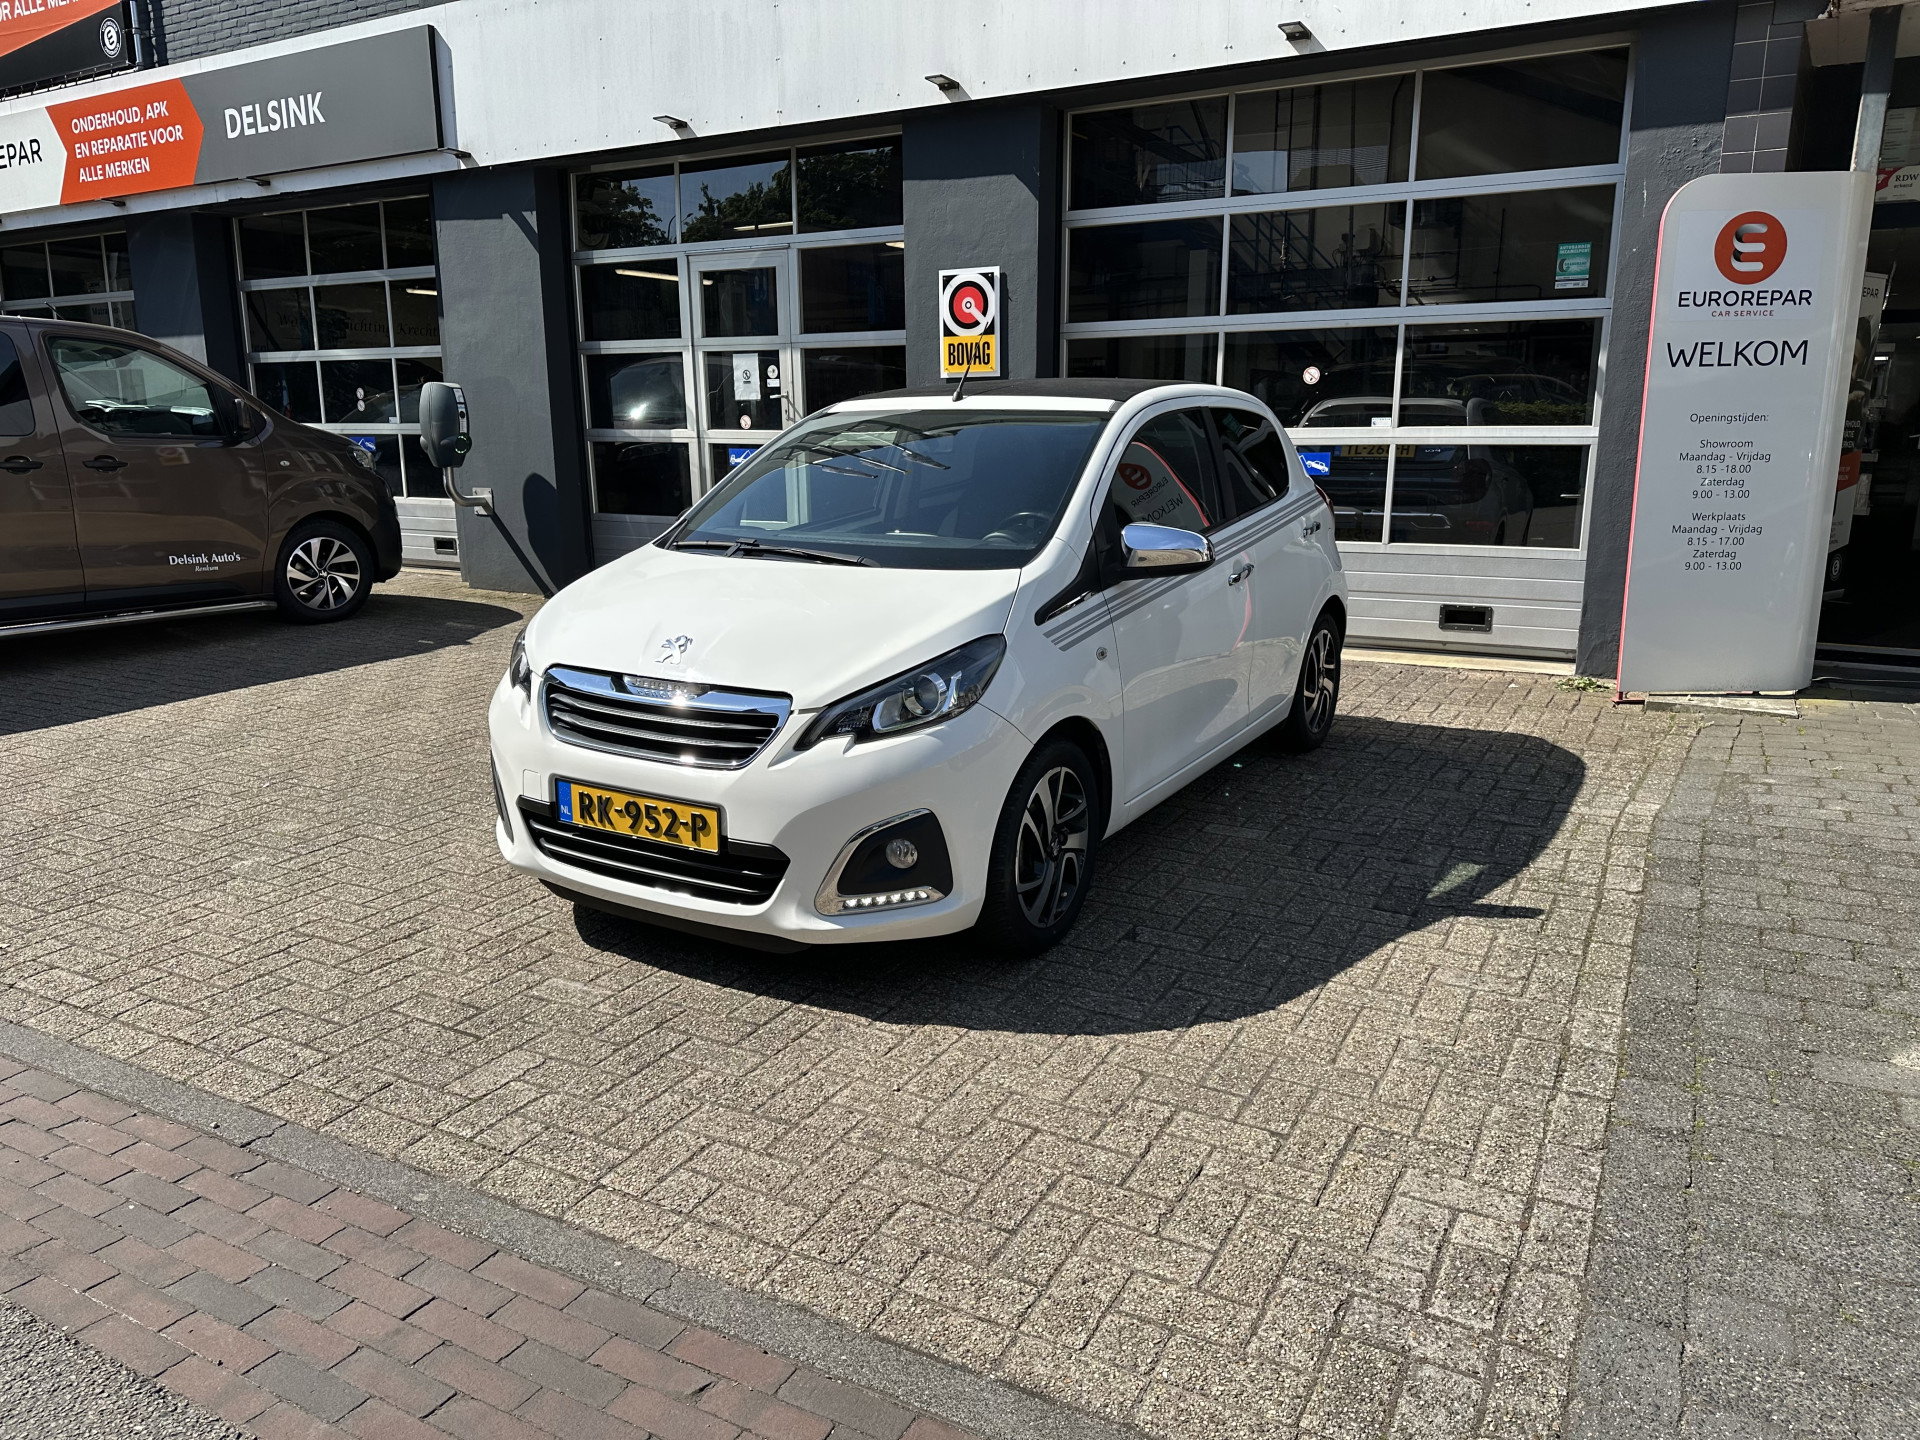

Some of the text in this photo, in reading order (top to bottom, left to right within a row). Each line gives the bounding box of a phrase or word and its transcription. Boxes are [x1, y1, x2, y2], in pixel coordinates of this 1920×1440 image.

[14, 0, 46, 18] ALLE
[71, 100, 169, 134] ONDERHOUD, APK
[224, 91, 326, 139] DELSINK
[74, 125, 184, 159] EN REPARATIE VOOR
[79, 157, 151, 183] ALLE MERKEN
[1894, 173, 1920, 182] RDW
[1678, 289, 1813, 308] EUROREPAR
[1711, 309, 1774, 318] CAR SERVICE
[947, 340, 991, 367] BOVAG
[1666, 339, 1809, 368] WELKOM
[1689, 412, 1769, 425] Openingstijden:
[1699, 439, 1754, 449] Showroom
[1679, 452, 1726, 463] Maandag
[1736, 451, 1771, 463] Vrijdag
[1696, 464, 1717, 474] 8.15
[1700, 476, 1745, 488] Zaterdag
[1692, 489, 1713, 499] 9.00
[1724, 489, 1750, 499] 13.00
[1691, 512, 1746, 524] Werkplaats
[1671, 524, 1718, 536] Maandag
[1728, 524, 1763, 536] Vrijdag
[1687, 536, 1708, 546] 8.15
[1718, 536, 1745, 546] 17.00
[168, 551, 241, 565] Delsink Auto's
[1692, 549, 1737, 560] Zaterdag
[1684, 561, 1705, 571] 9.00
[1715, 561, 1742, 571] 13.00
[560, 804, 571, 816] NL
[578, 790, 709, 842] RK-952-P
